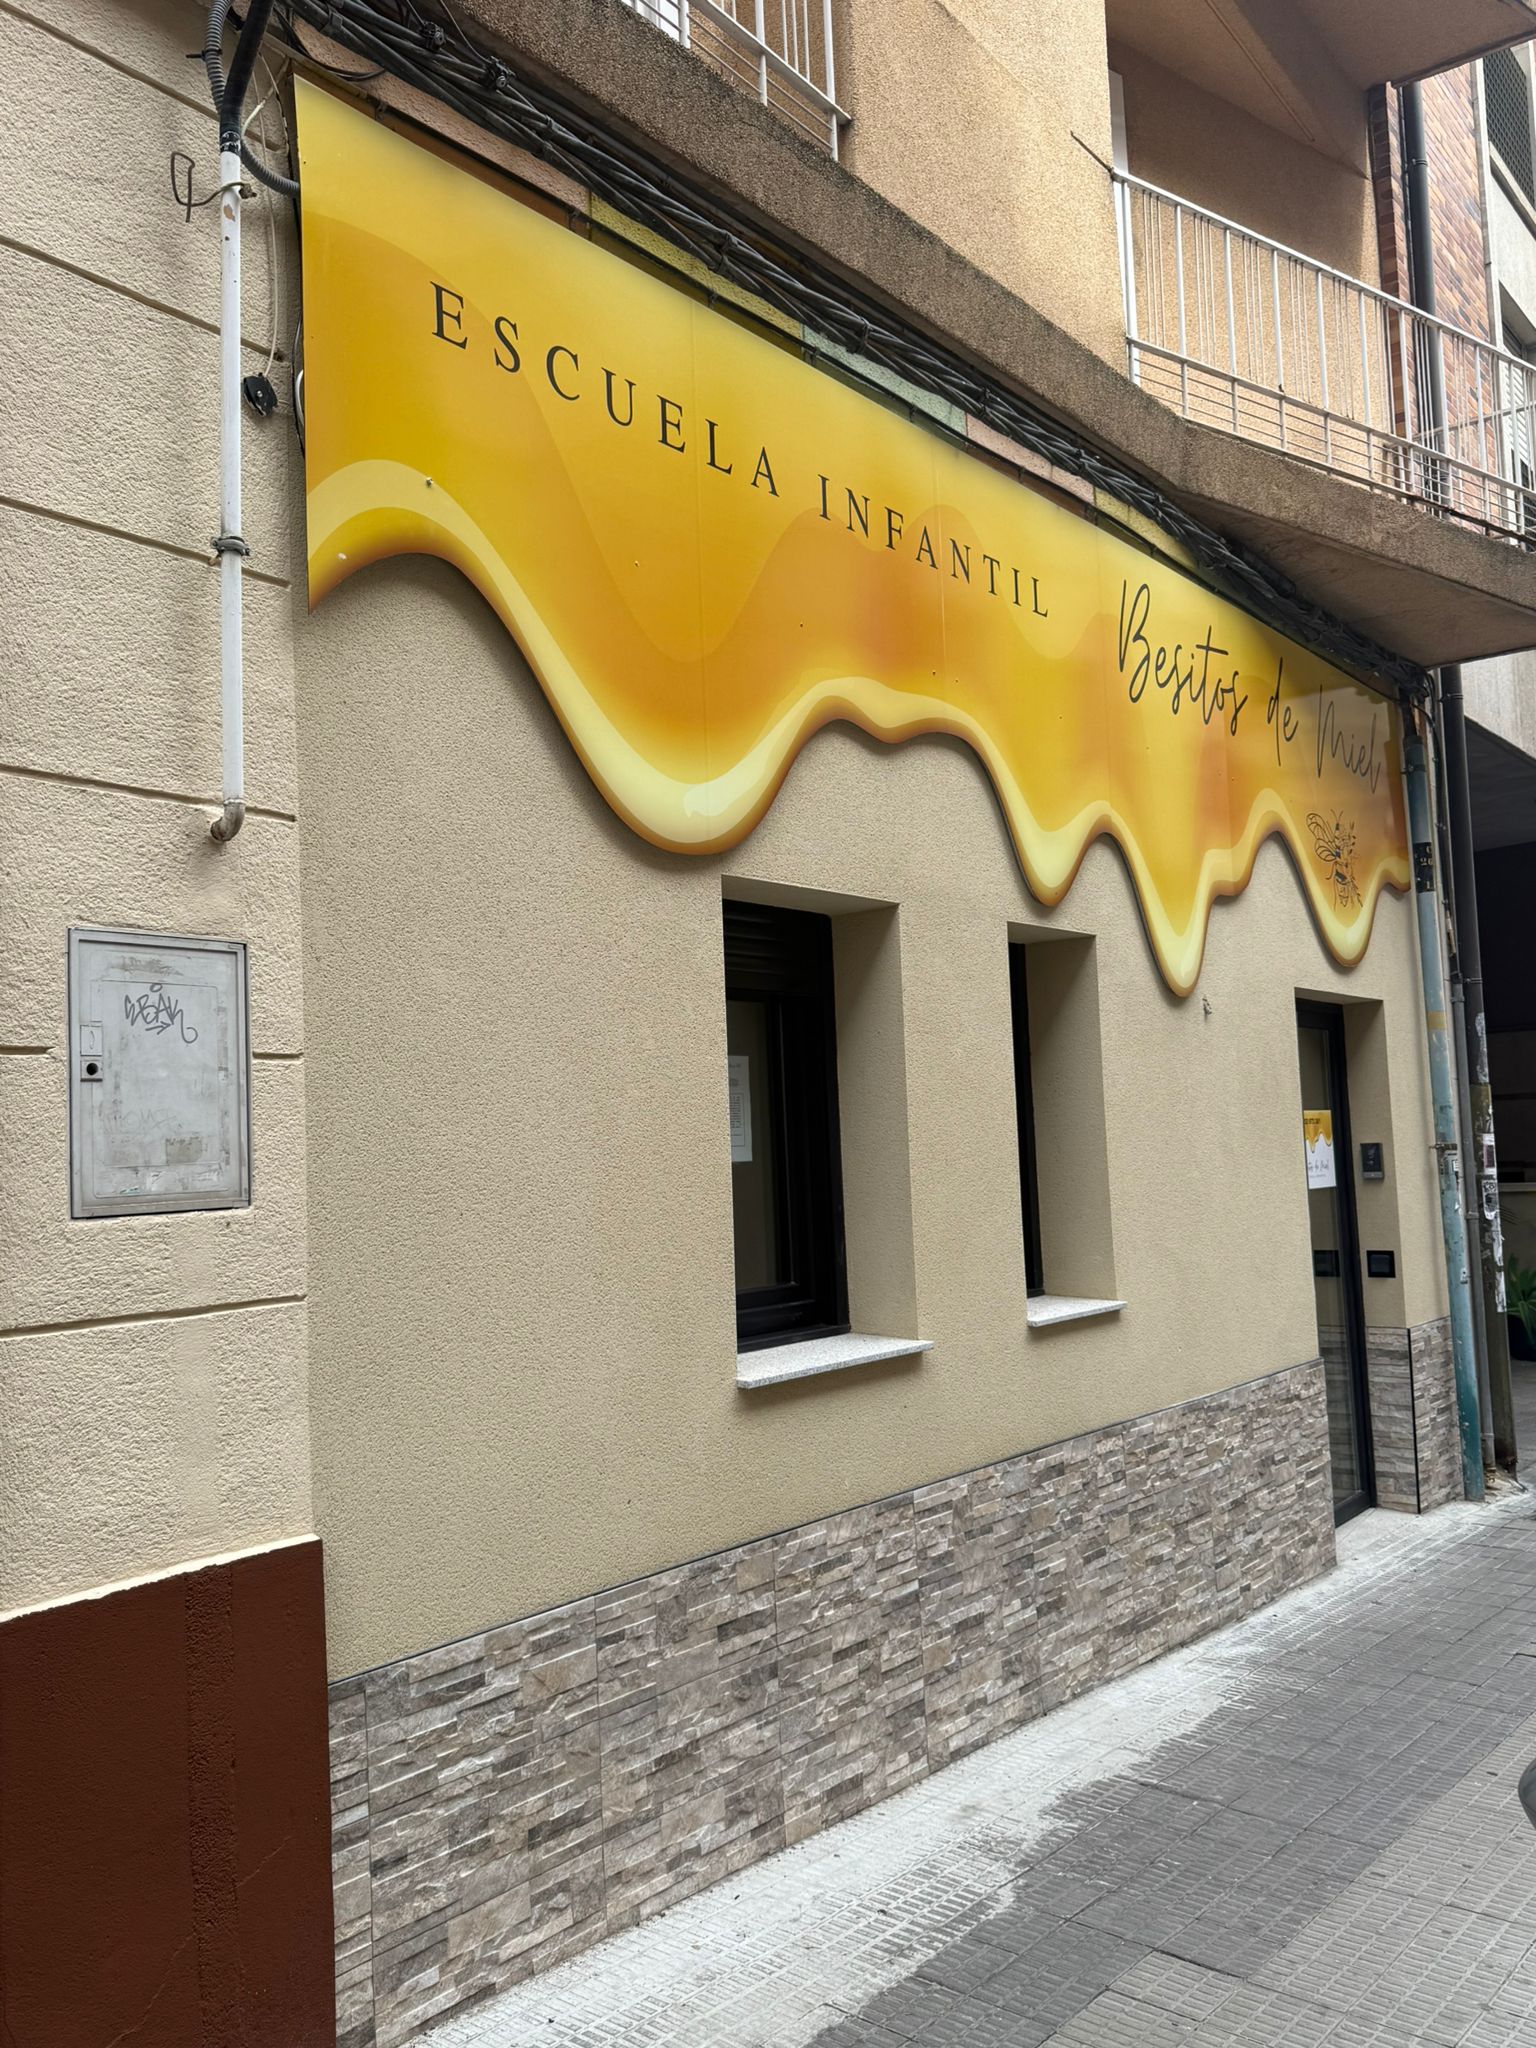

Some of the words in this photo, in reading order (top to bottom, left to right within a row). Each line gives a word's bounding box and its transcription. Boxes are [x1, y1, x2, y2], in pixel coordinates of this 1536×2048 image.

[430, 280, 780, 498] ESCUELA
[818, 473, 1049, 618] INFANTIL
[1118, 578, 1249, 737] Besitos
[1266, 656, 1299, 767] de
[1316, 683, 1382, 795] Miel
